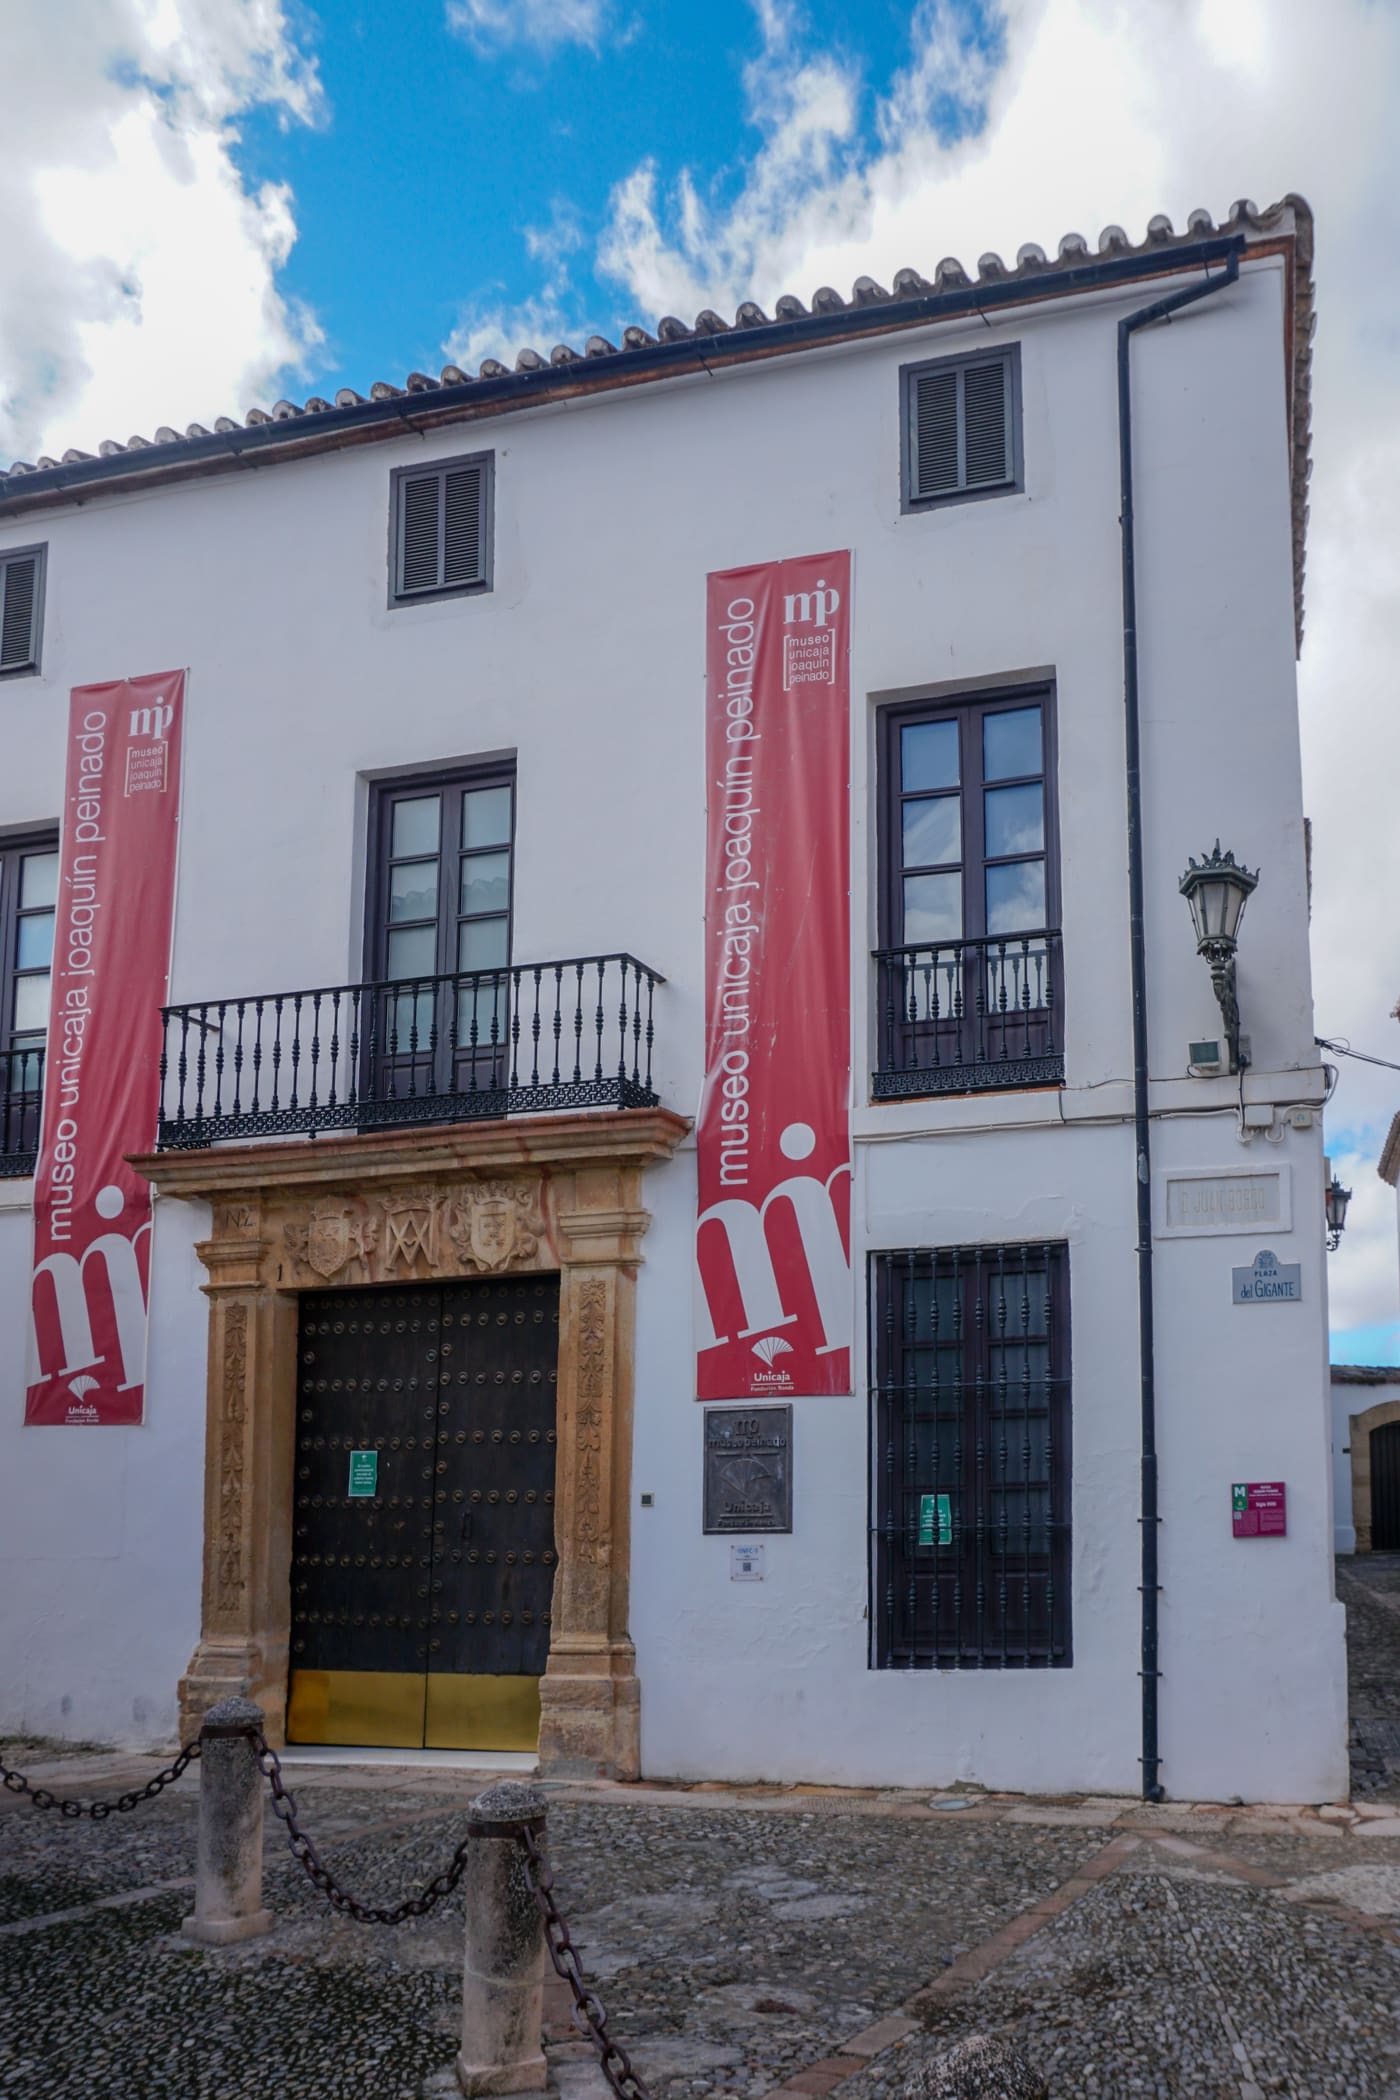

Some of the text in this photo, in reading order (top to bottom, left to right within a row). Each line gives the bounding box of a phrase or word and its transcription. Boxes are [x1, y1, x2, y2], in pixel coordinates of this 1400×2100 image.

[789, 634, 829, 647] museo
[789, 646, 829, 659] unicaja
[789, 671, 829, 684] peinado
[131, 746, 163, 758] museo
[130, 757, 163, 770] unicaja
[129, 780, 161, 792] peinado
[716, 598, 761, 1186] museo unicaja joaquín peinado
[50, 710, 106, 1241] museo unicaja joaquín peinado
[1254, 1269, 1277, 1278] PLAZA
[1240, 1279, 1294, 1298] del GIGANTE
[754, 1370, 791, 1382] Unicaja
[68, 1405, 97, 1416] Unicaja
[1234, 1486, 1246, 1497] M
